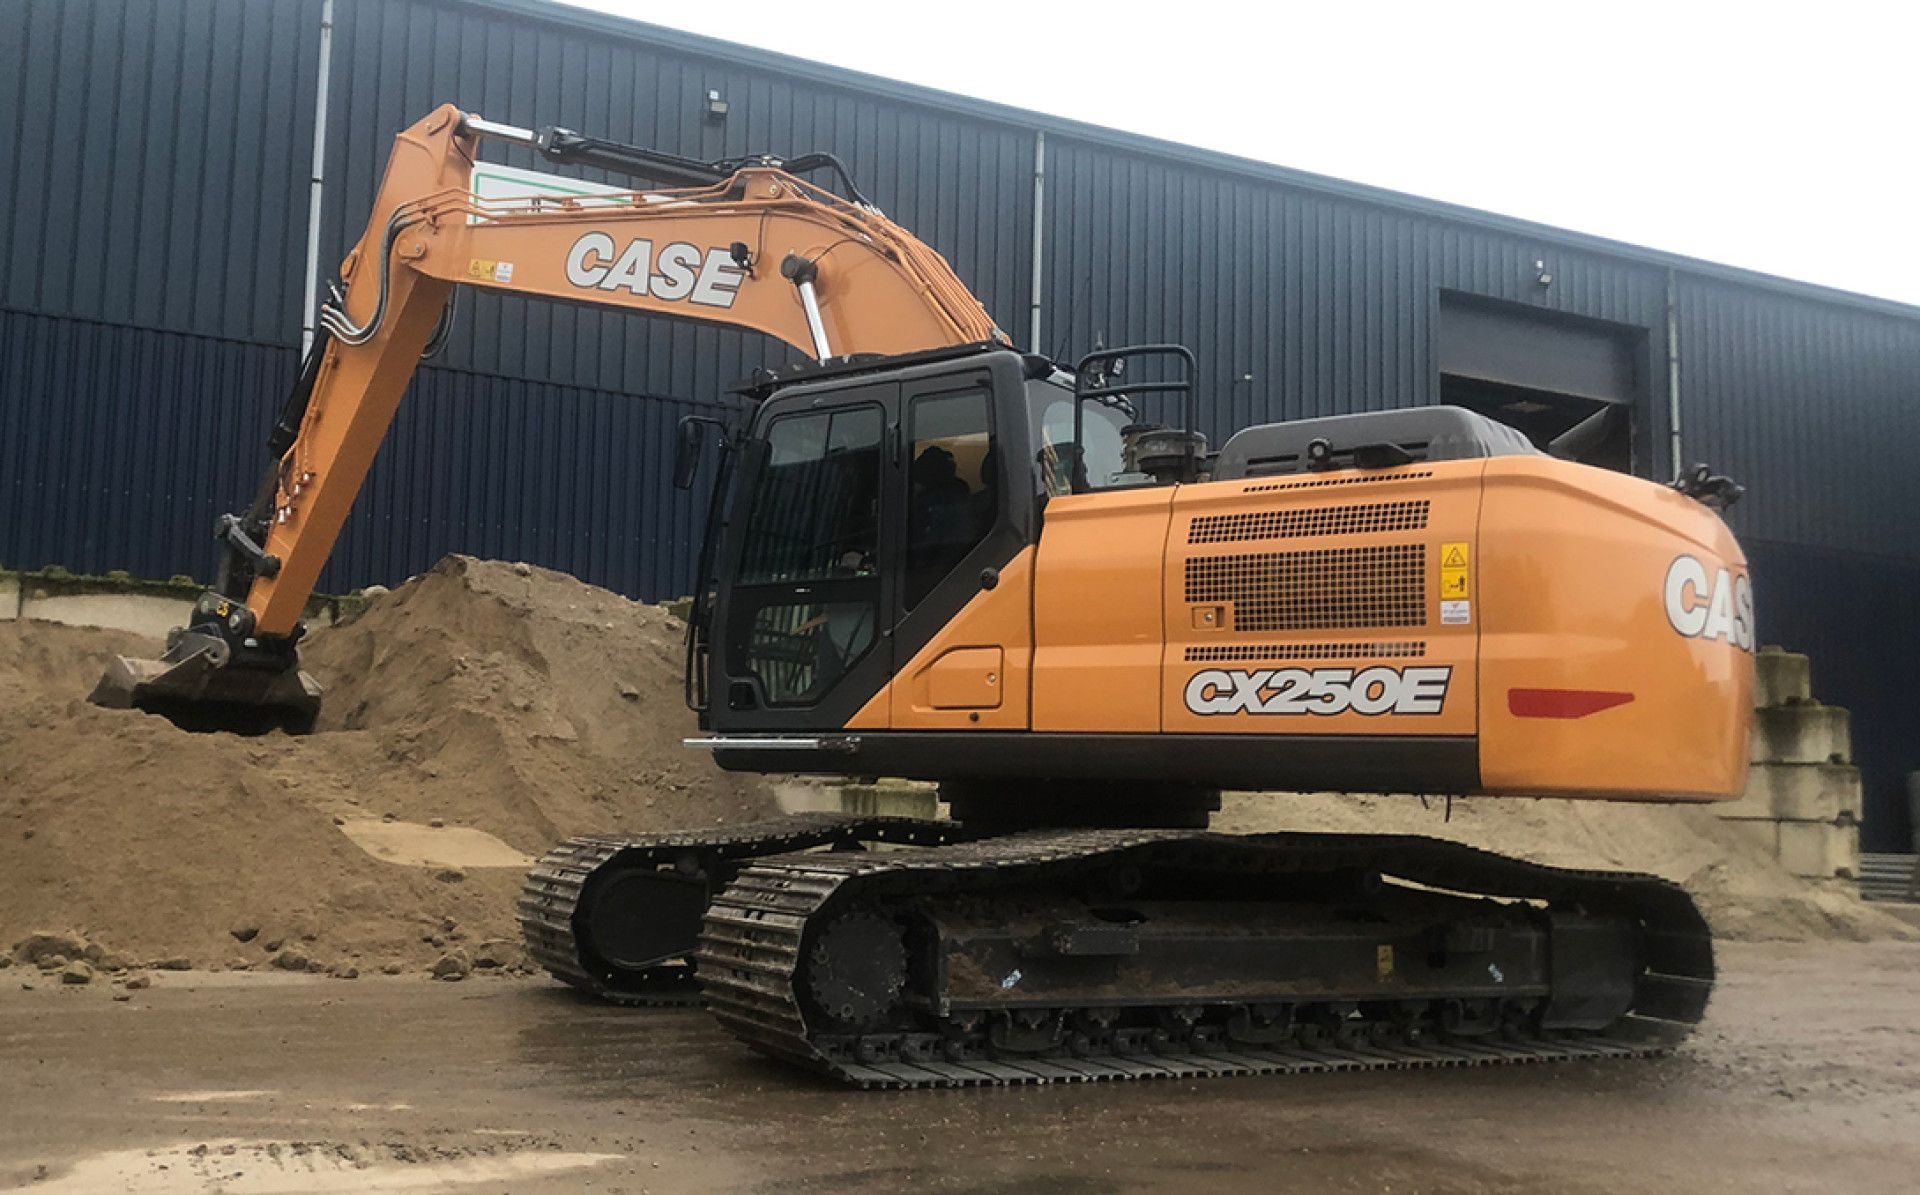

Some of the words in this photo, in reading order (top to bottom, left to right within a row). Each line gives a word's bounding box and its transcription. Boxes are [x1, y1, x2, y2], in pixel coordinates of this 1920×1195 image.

[566, 231, 747, 308] CASE
[1664, 554, 1755, 653] CAS
[1184, 665, 1453, 716] CX250E
